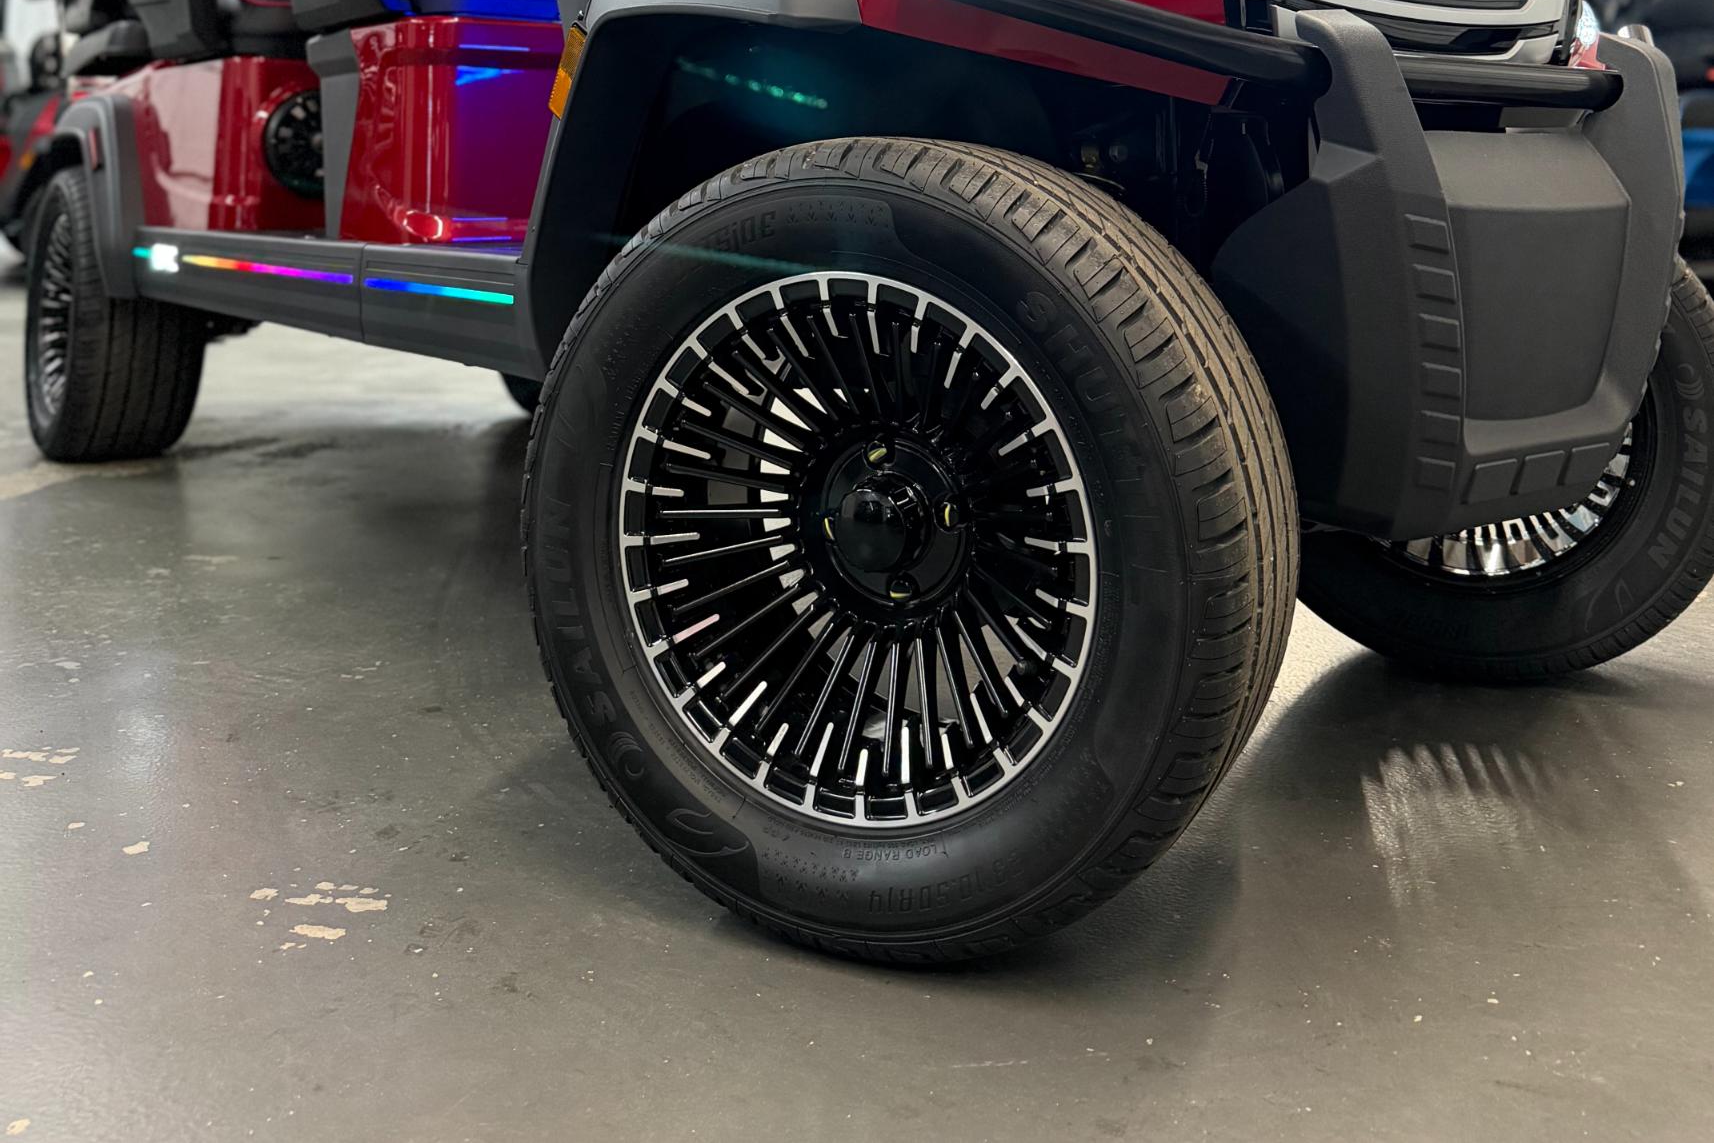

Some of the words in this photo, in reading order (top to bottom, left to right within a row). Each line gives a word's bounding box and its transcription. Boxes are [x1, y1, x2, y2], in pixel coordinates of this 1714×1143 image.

[1648, 406, 1709, 570] SAILUN
[547, 496, 617, 724] SAILUN
[857, 849, 901, 862] RANGE
[908, 843, 938, 860] LOAD
